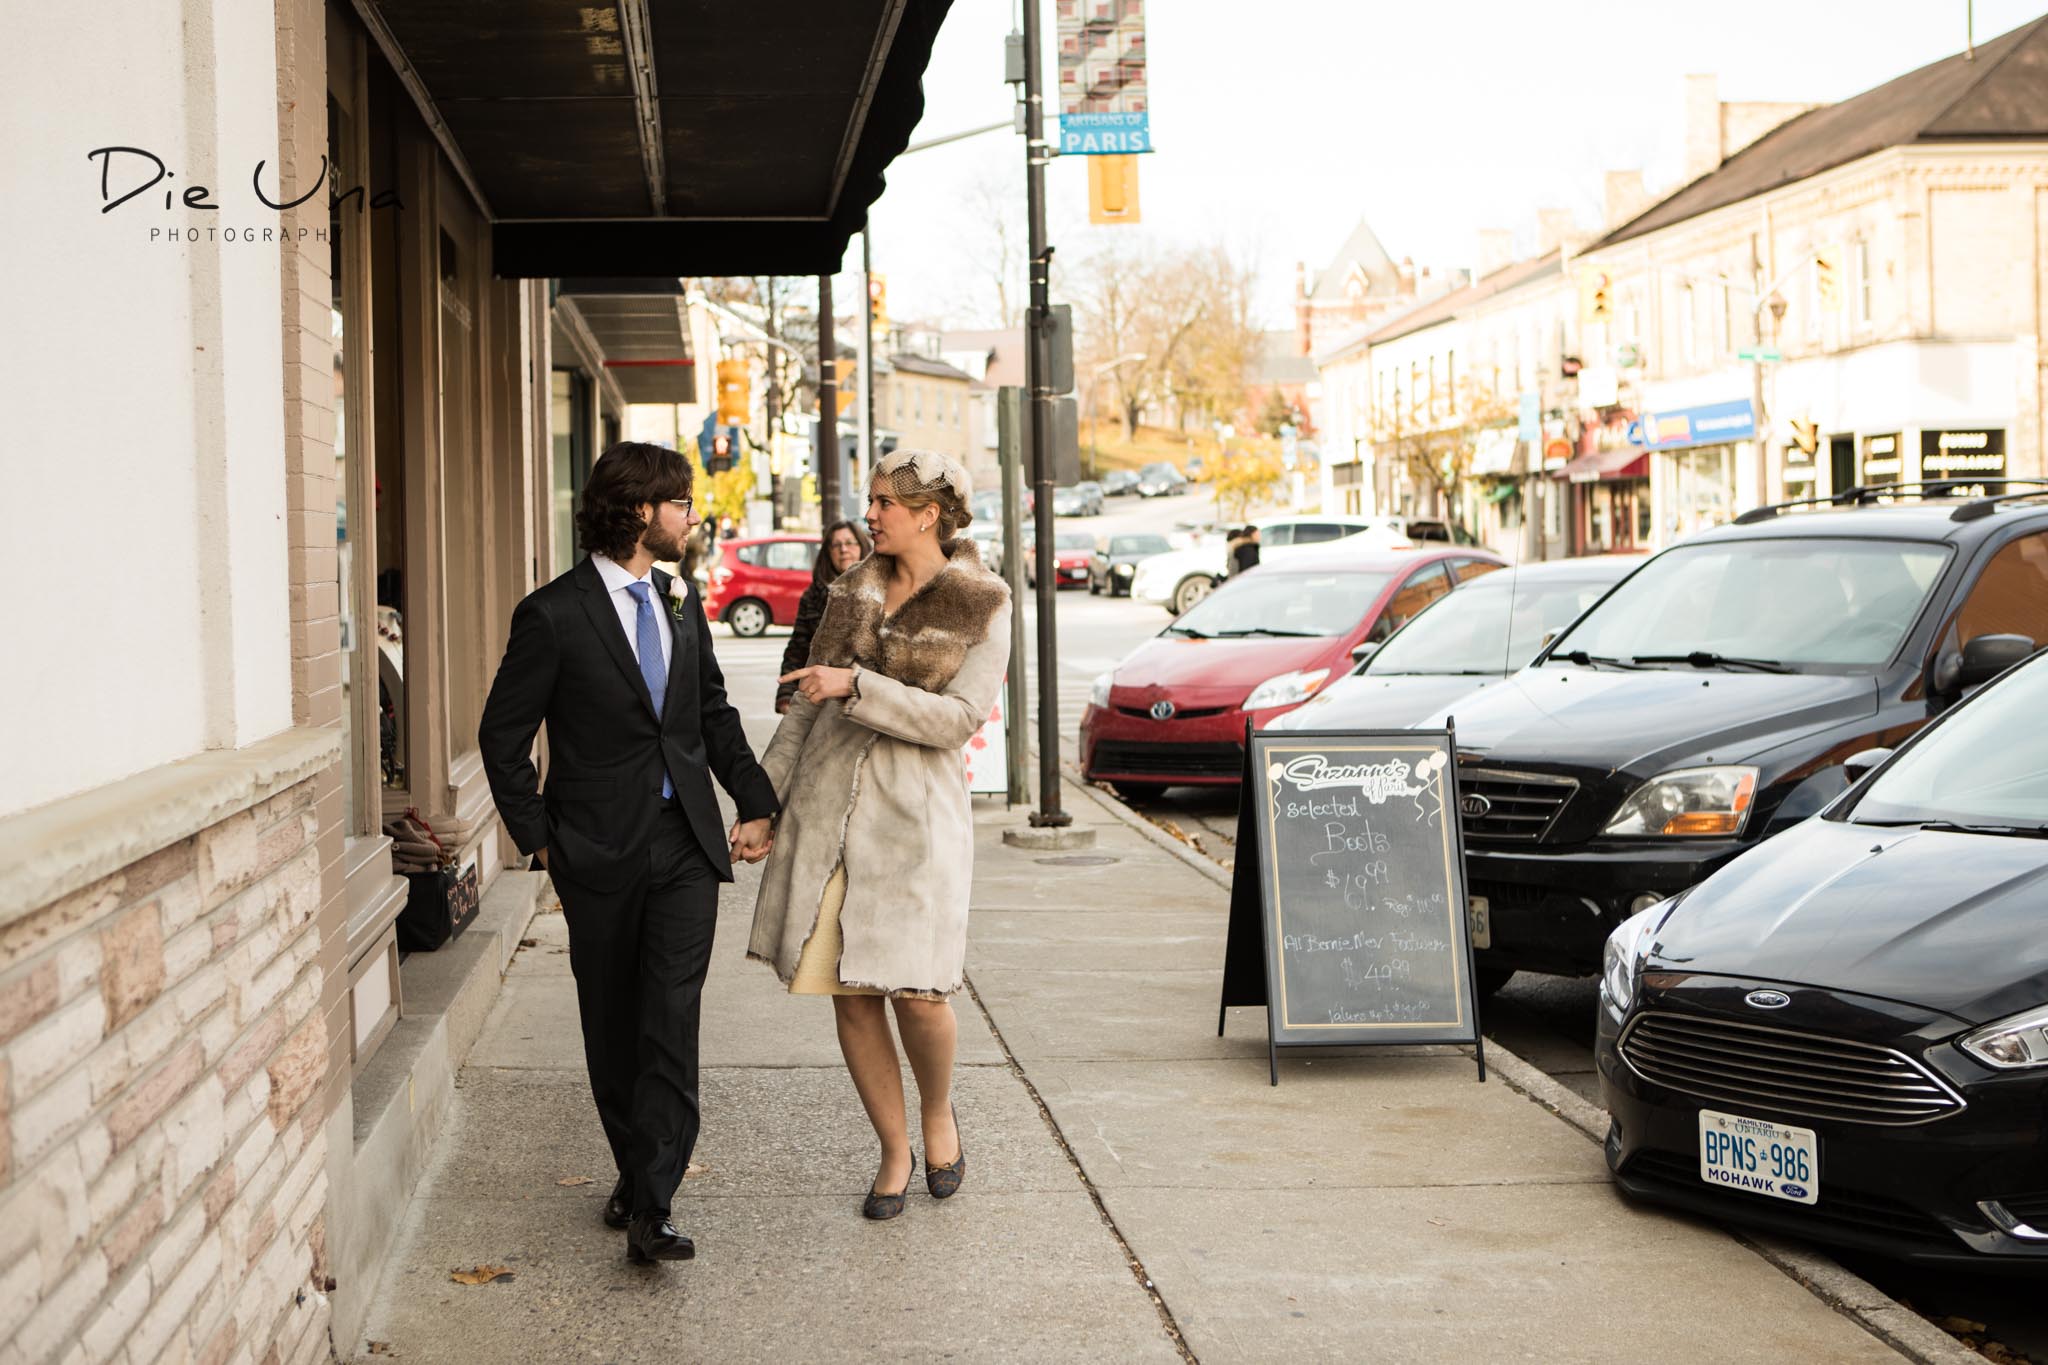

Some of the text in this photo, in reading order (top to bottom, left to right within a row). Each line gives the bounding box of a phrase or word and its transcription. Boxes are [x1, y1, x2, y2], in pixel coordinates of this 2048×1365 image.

[1066, 131, 1145, 152] PARIS
[1284, 755, 1409, 790] Suzanne's
[1737, 1118, 1774, 1130] HAMILTON
[1706, 1130, 1809, 1182] BPNS 986
[1708, 1167, 1775, 1192] MOHAWK
